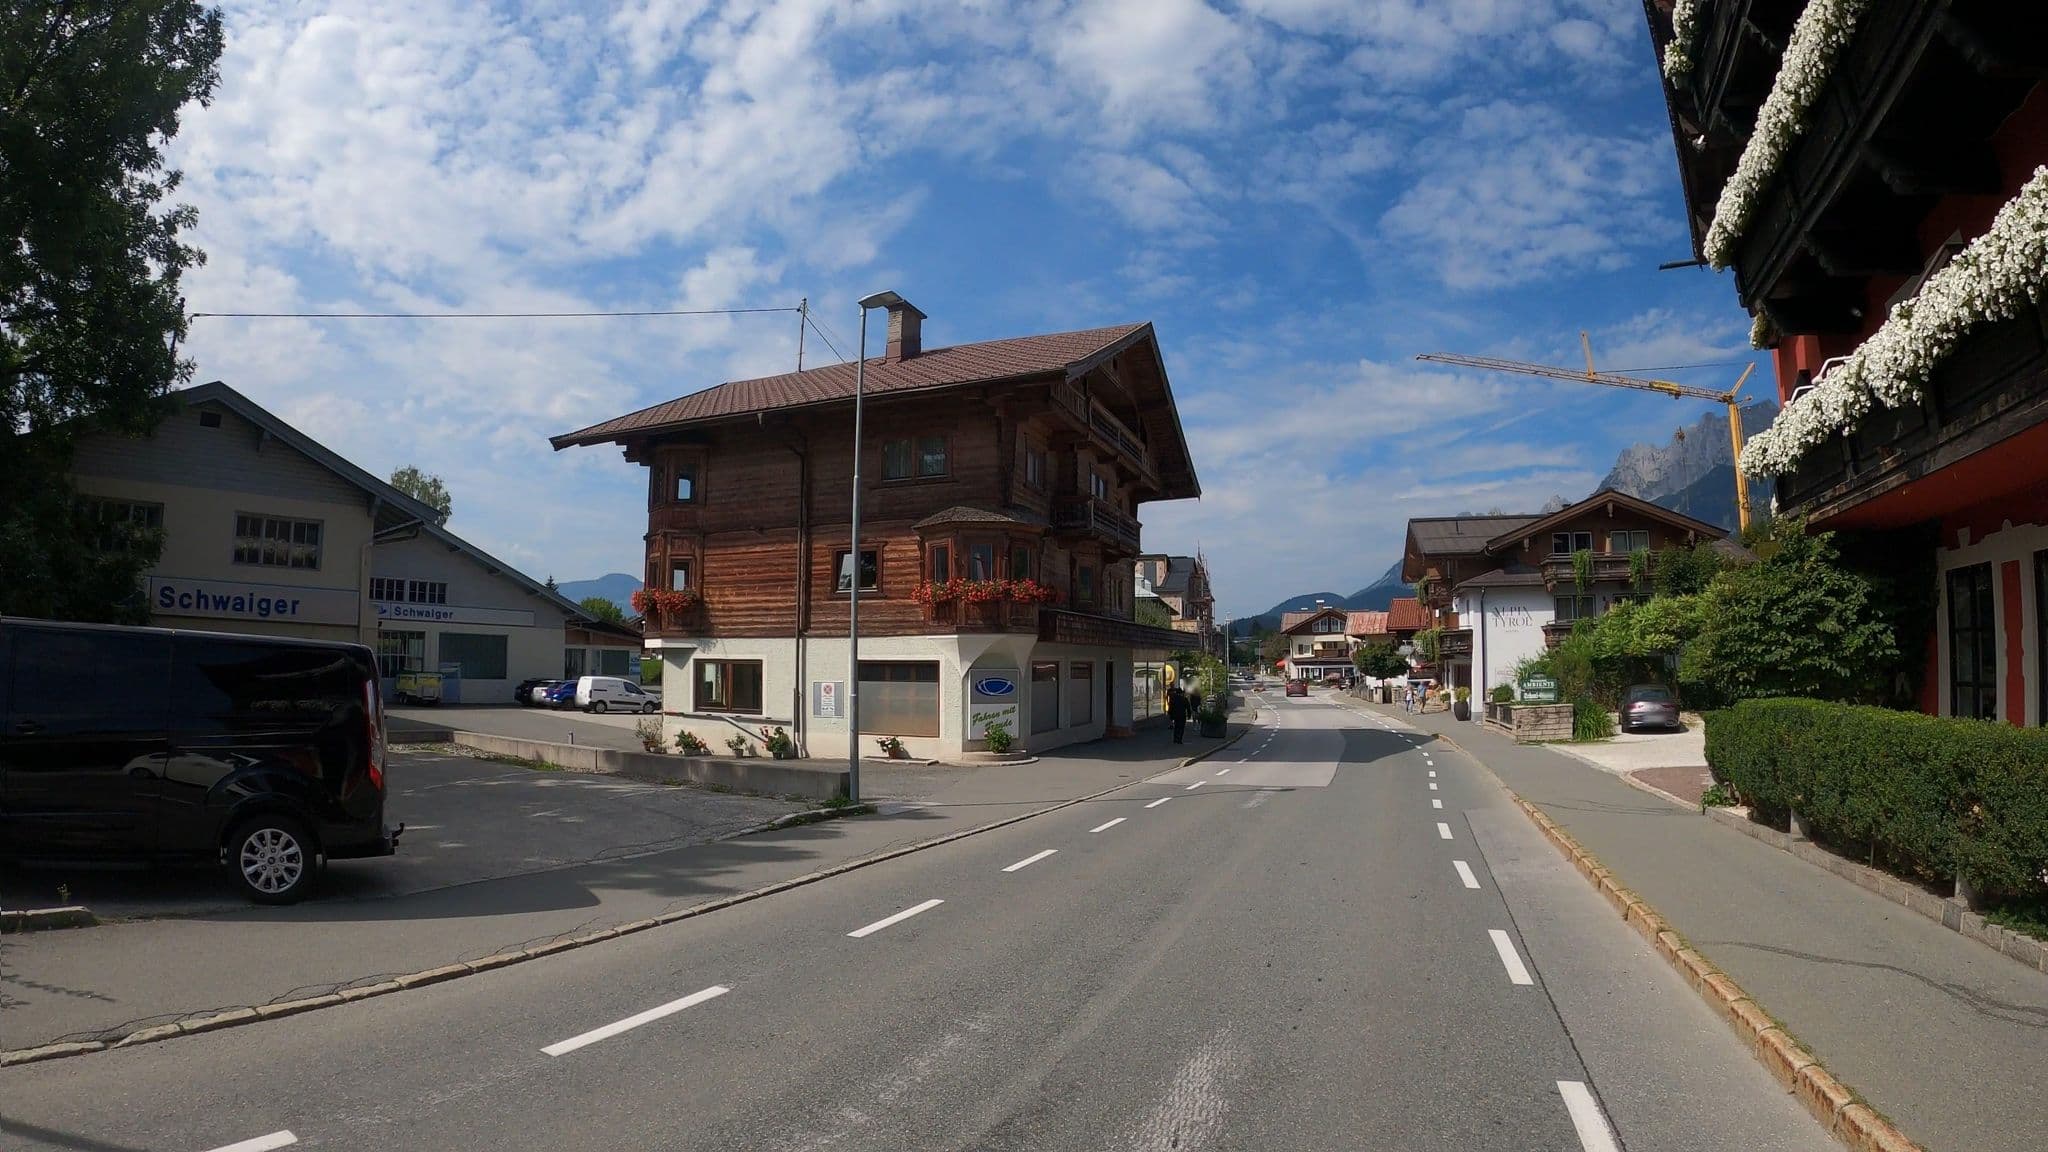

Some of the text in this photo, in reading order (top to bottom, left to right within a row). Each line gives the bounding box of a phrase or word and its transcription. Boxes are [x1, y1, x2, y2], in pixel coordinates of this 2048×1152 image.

[159, 586, 299, 617] Schwaiger
[394, 606, 454, 619] Schwaiger
[1492, 616, 1532, 627] TYROL
[972, 705, 1016, 726] Fahren mit
